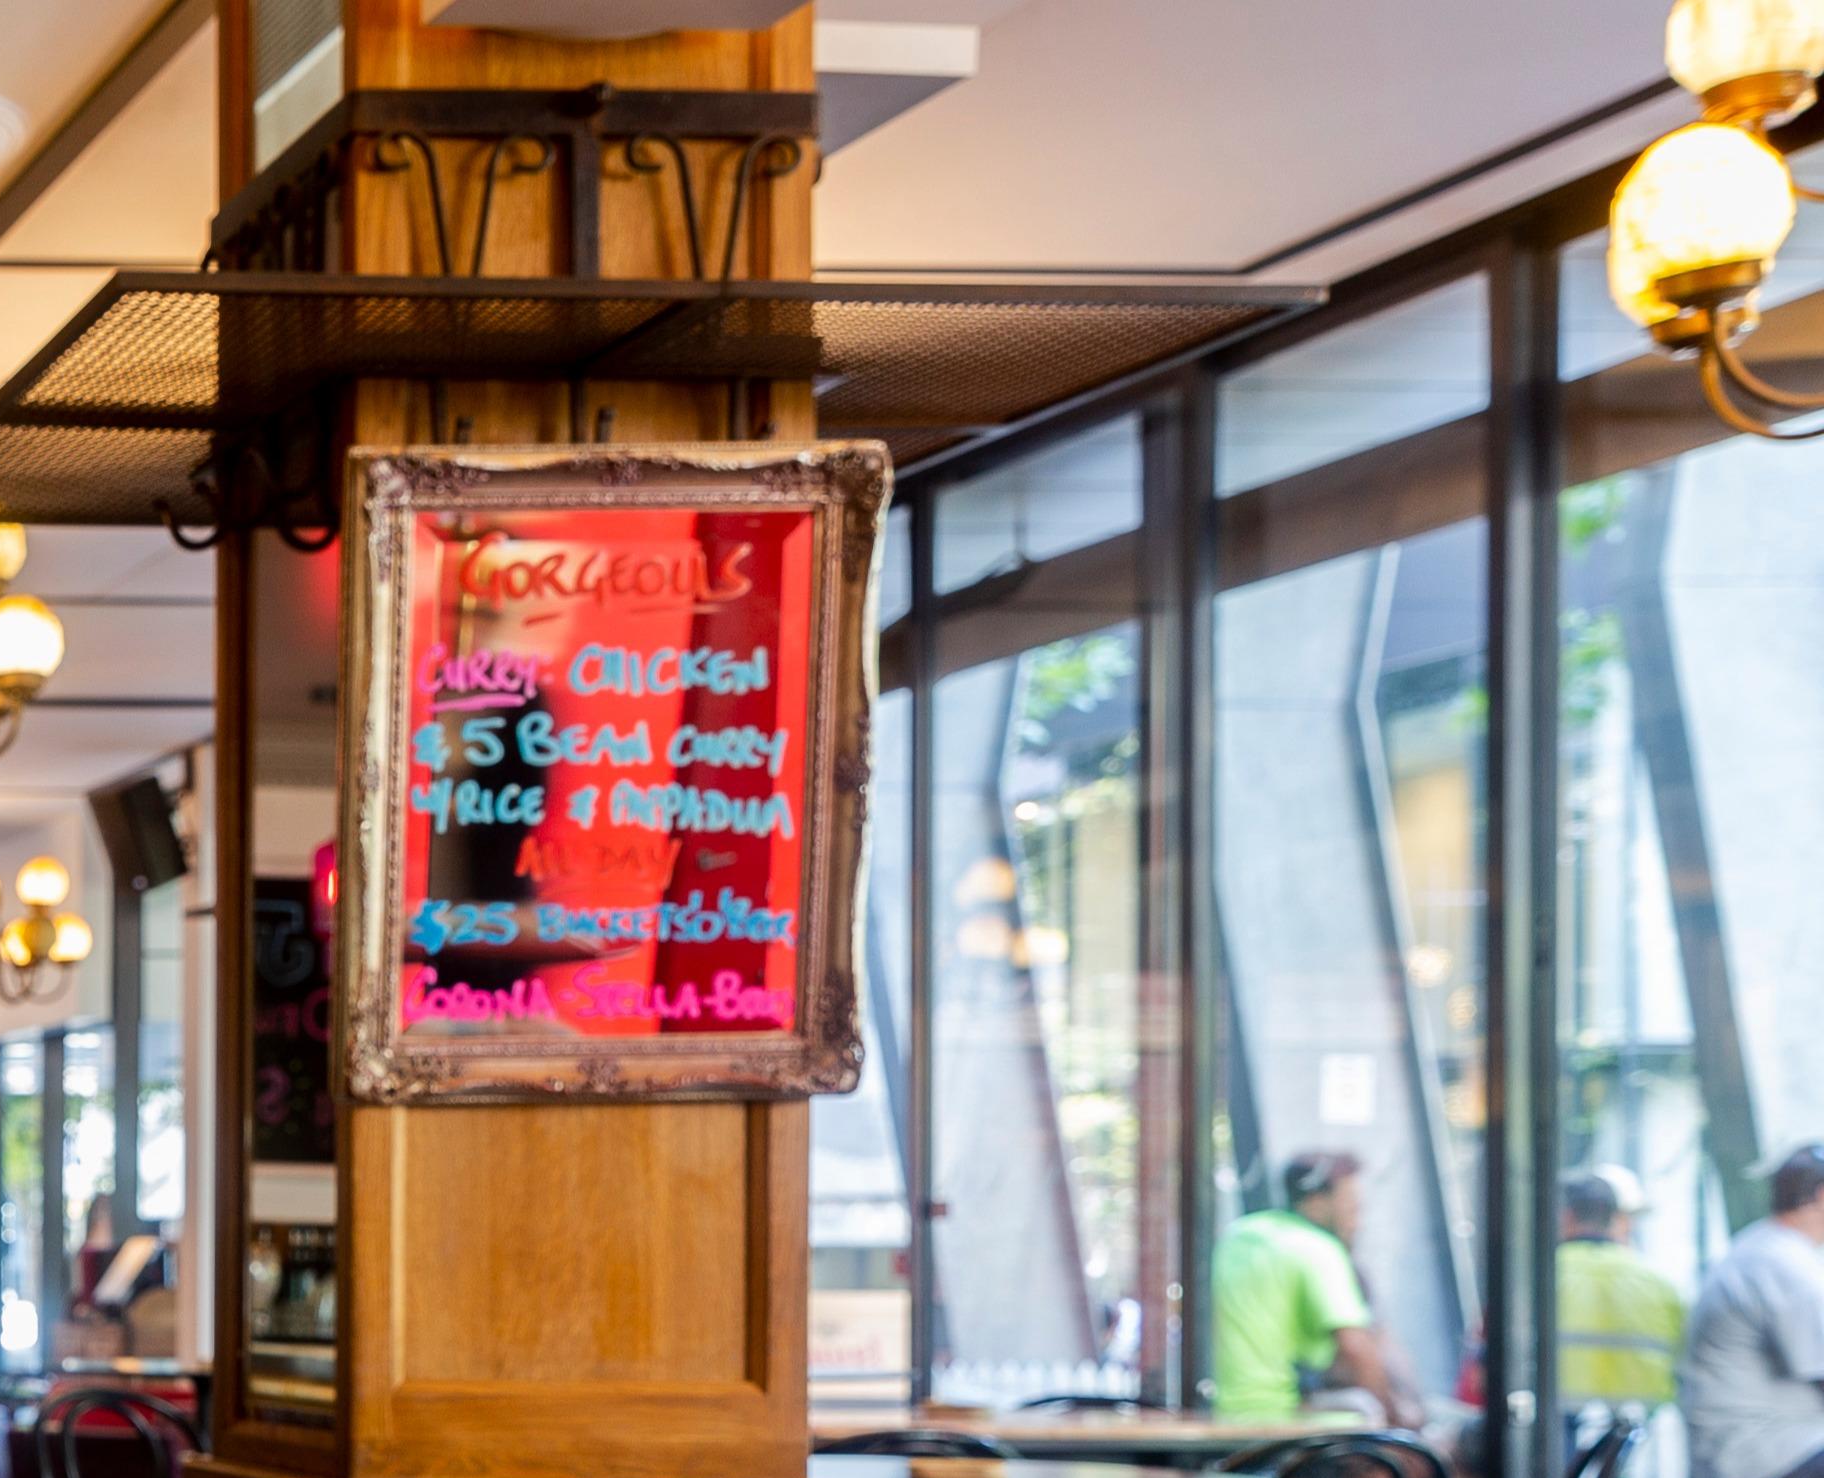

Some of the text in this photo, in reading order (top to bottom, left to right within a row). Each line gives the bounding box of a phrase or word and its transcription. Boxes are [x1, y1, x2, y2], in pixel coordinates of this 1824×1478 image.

[459, 532, 753, 605] GORGEOUS
[569, 642, 770, 697] CHICKEN
[460, 715, 508, 767] 5
[515, 710, 654, 768] BEAN
[408, 897, 521, 956] $25
